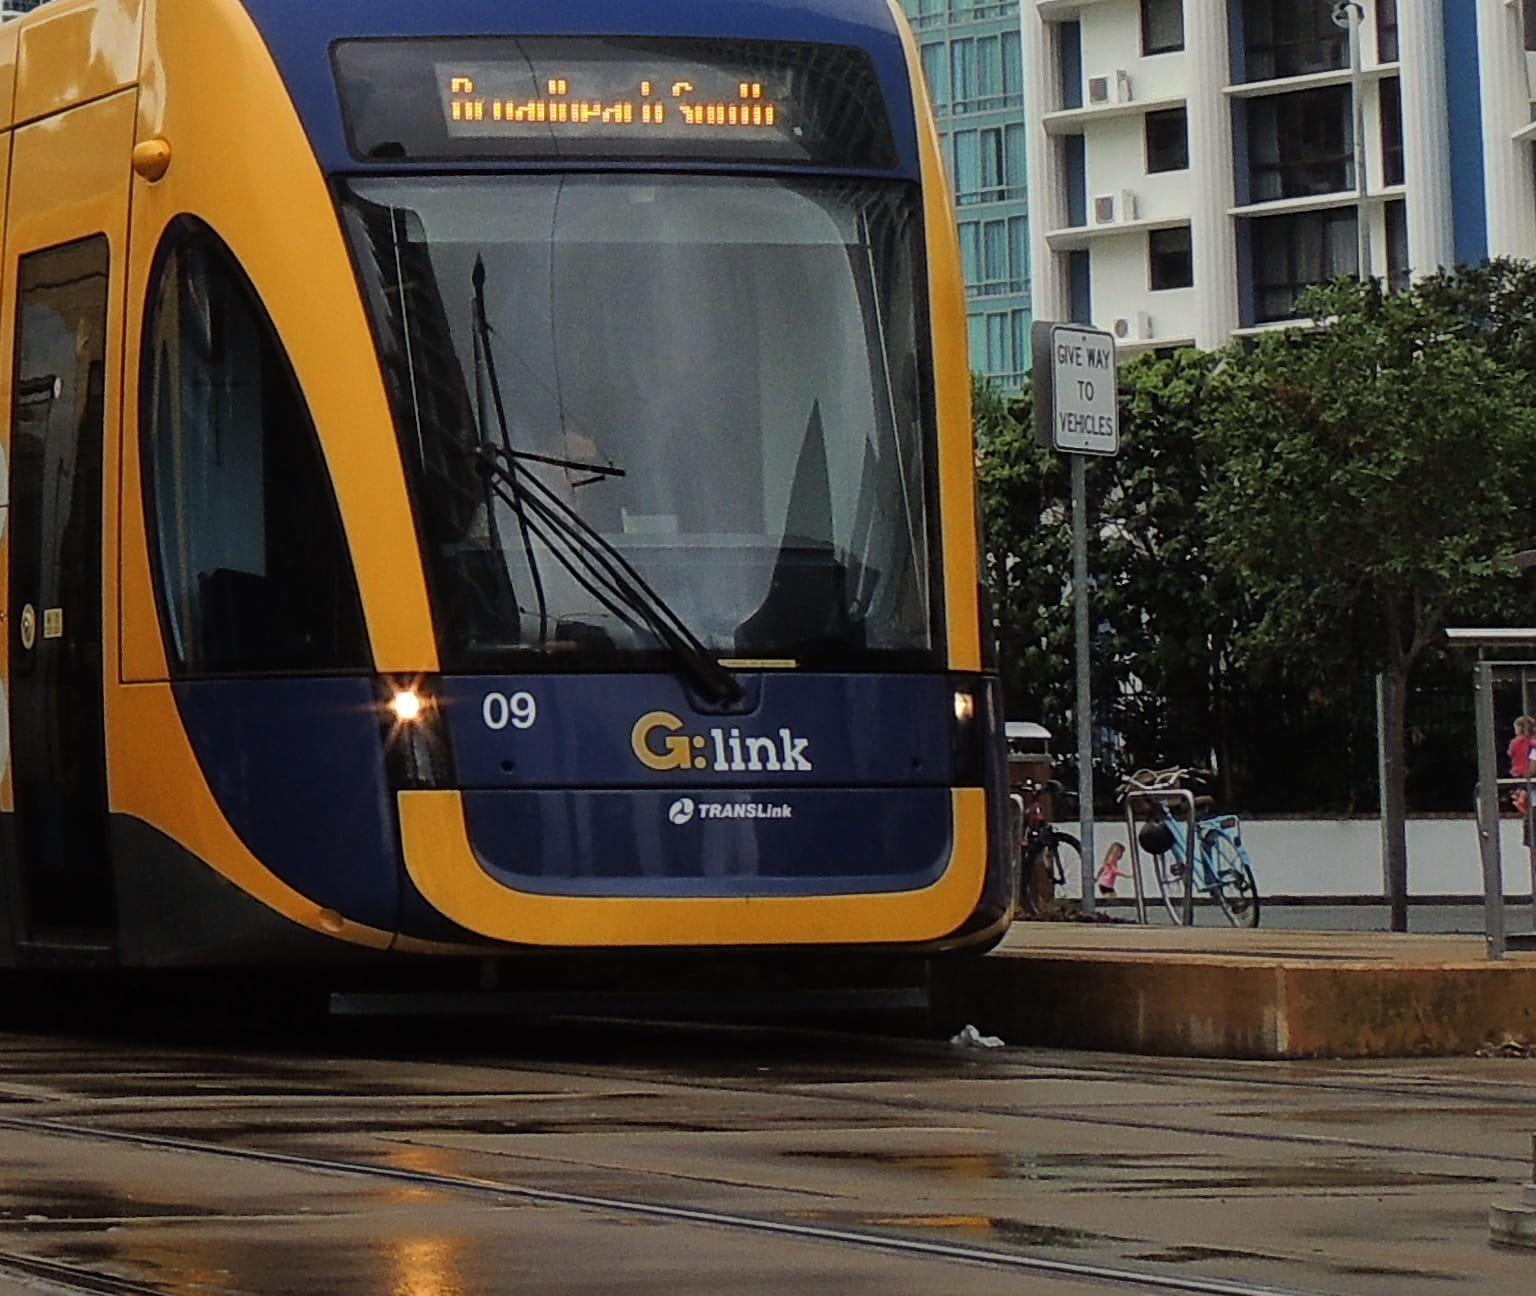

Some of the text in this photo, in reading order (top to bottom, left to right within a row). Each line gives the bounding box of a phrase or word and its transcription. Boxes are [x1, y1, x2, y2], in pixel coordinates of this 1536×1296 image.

[450, 77, 775, 126] Broadbeach South
[1057, 344, 1110, 370] GIVE WAY
[1077, 380, 1095, 401] TO
[1059, 412, 1113, 436] VEHICLES
[482, 691, 536, 729] 09
[699, 803, 793, 819] TRANSLink
